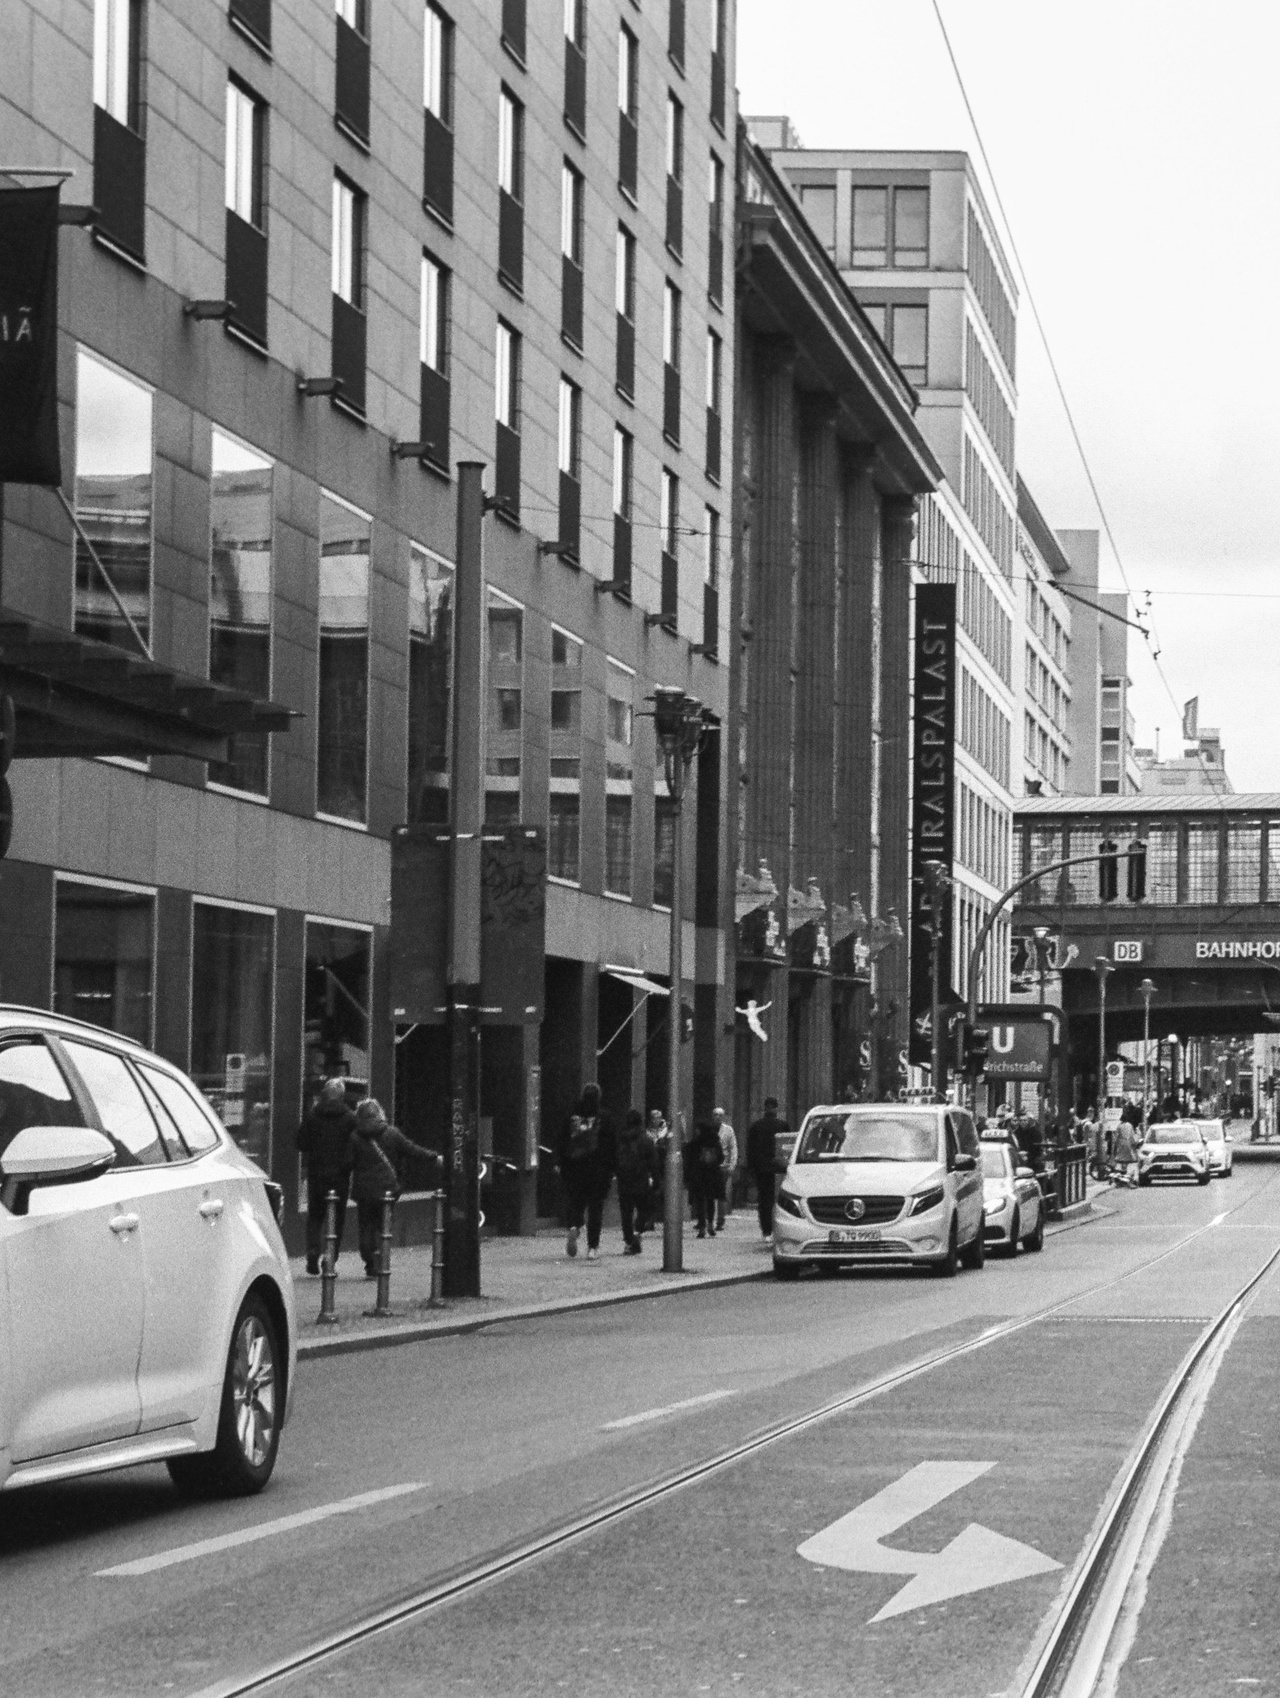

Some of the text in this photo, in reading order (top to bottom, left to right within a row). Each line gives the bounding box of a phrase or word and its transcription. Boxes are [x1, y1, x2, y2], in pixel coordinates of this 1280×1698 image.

[1, 305, 32, 342] IÃ
[919, 618, 947, 936] ADIRALSPALAST
[1116, 943, 1140, 960] DB
[993, 1026, 1015, 1053] U
[983, 1061, 1043, 1073] drichstraße
